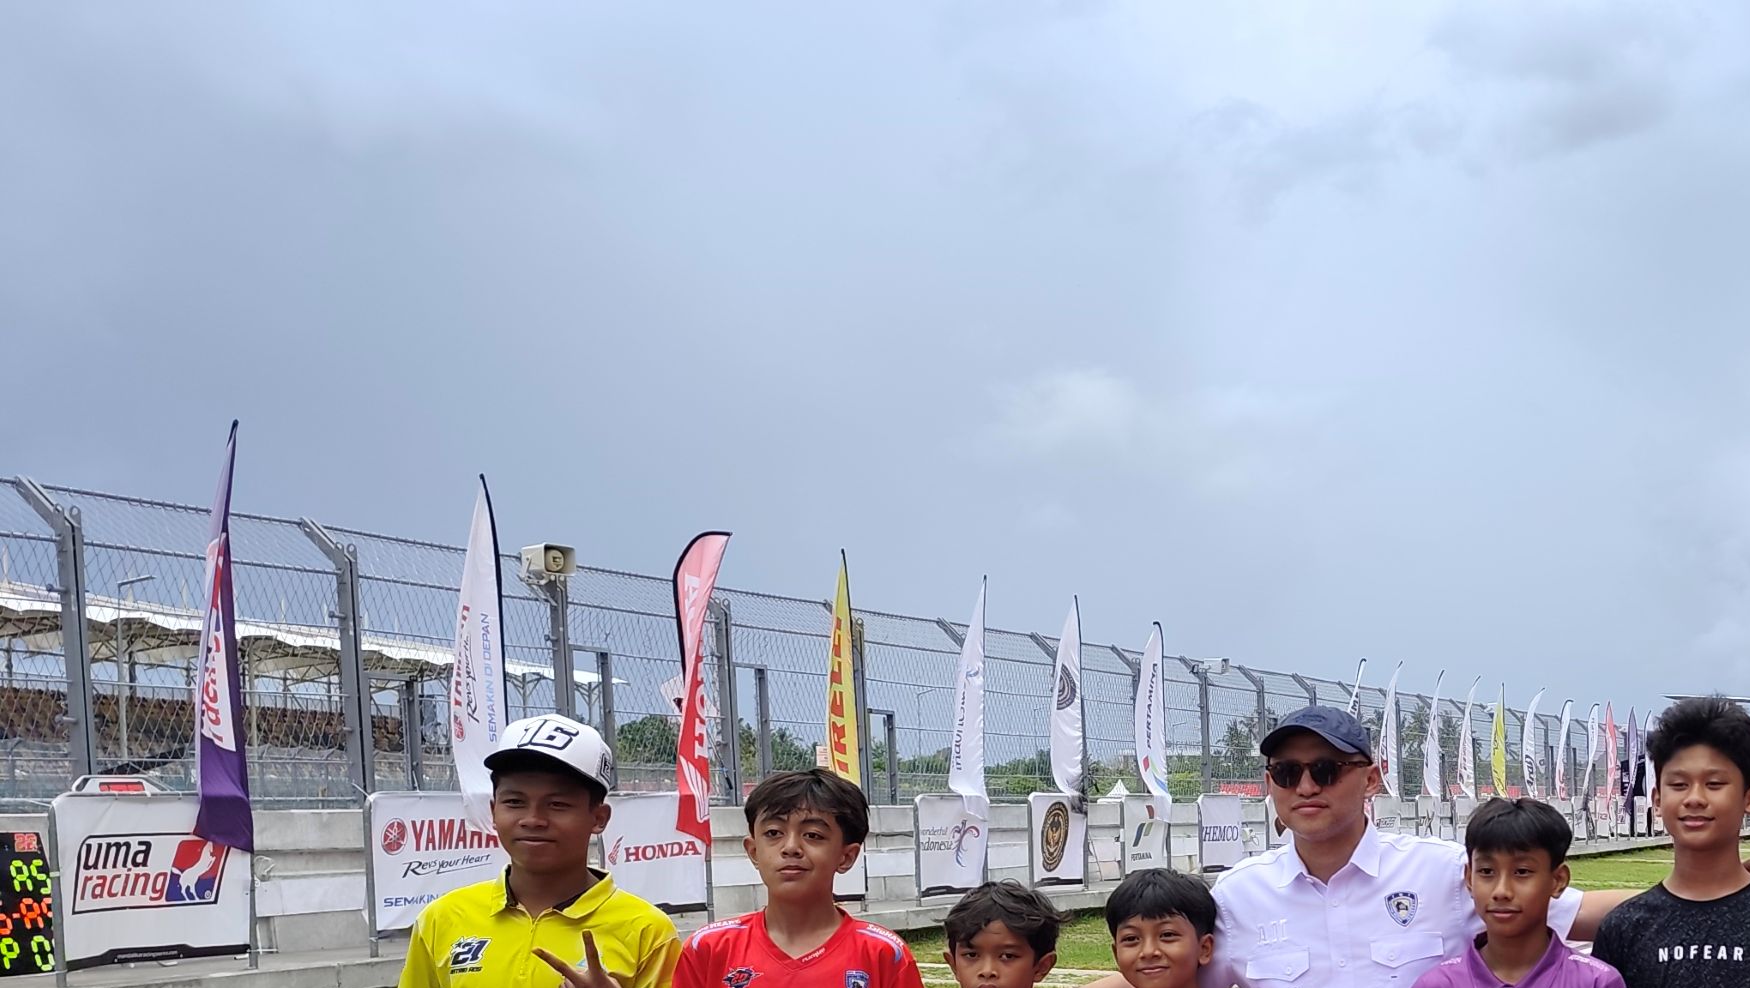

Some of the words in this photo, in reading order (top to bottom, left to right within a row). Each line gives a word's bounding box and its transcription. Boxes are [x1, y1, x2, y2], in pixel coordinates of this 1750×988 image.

[480, 613, 492, 661] DEPAN
[484, 662, 494, 677] DI
[830, 616, 850, 774] IRELLI
[1146, 662, 1159, 750] PERTAMINA
[485, 679, 498, 743] SEMAKIN
[517, 719, 579, 750] 16
[83, 840, 152, 871] uma
[624, 840, 702, 863] HONDA
[920, 837, 954, 851] ndonesia
[402, 858, 438, 879] Revs
[461, 853, 491, 869] Heart
[80, 867, 169, 901] racing
[450, 937, 491, 966] 21
